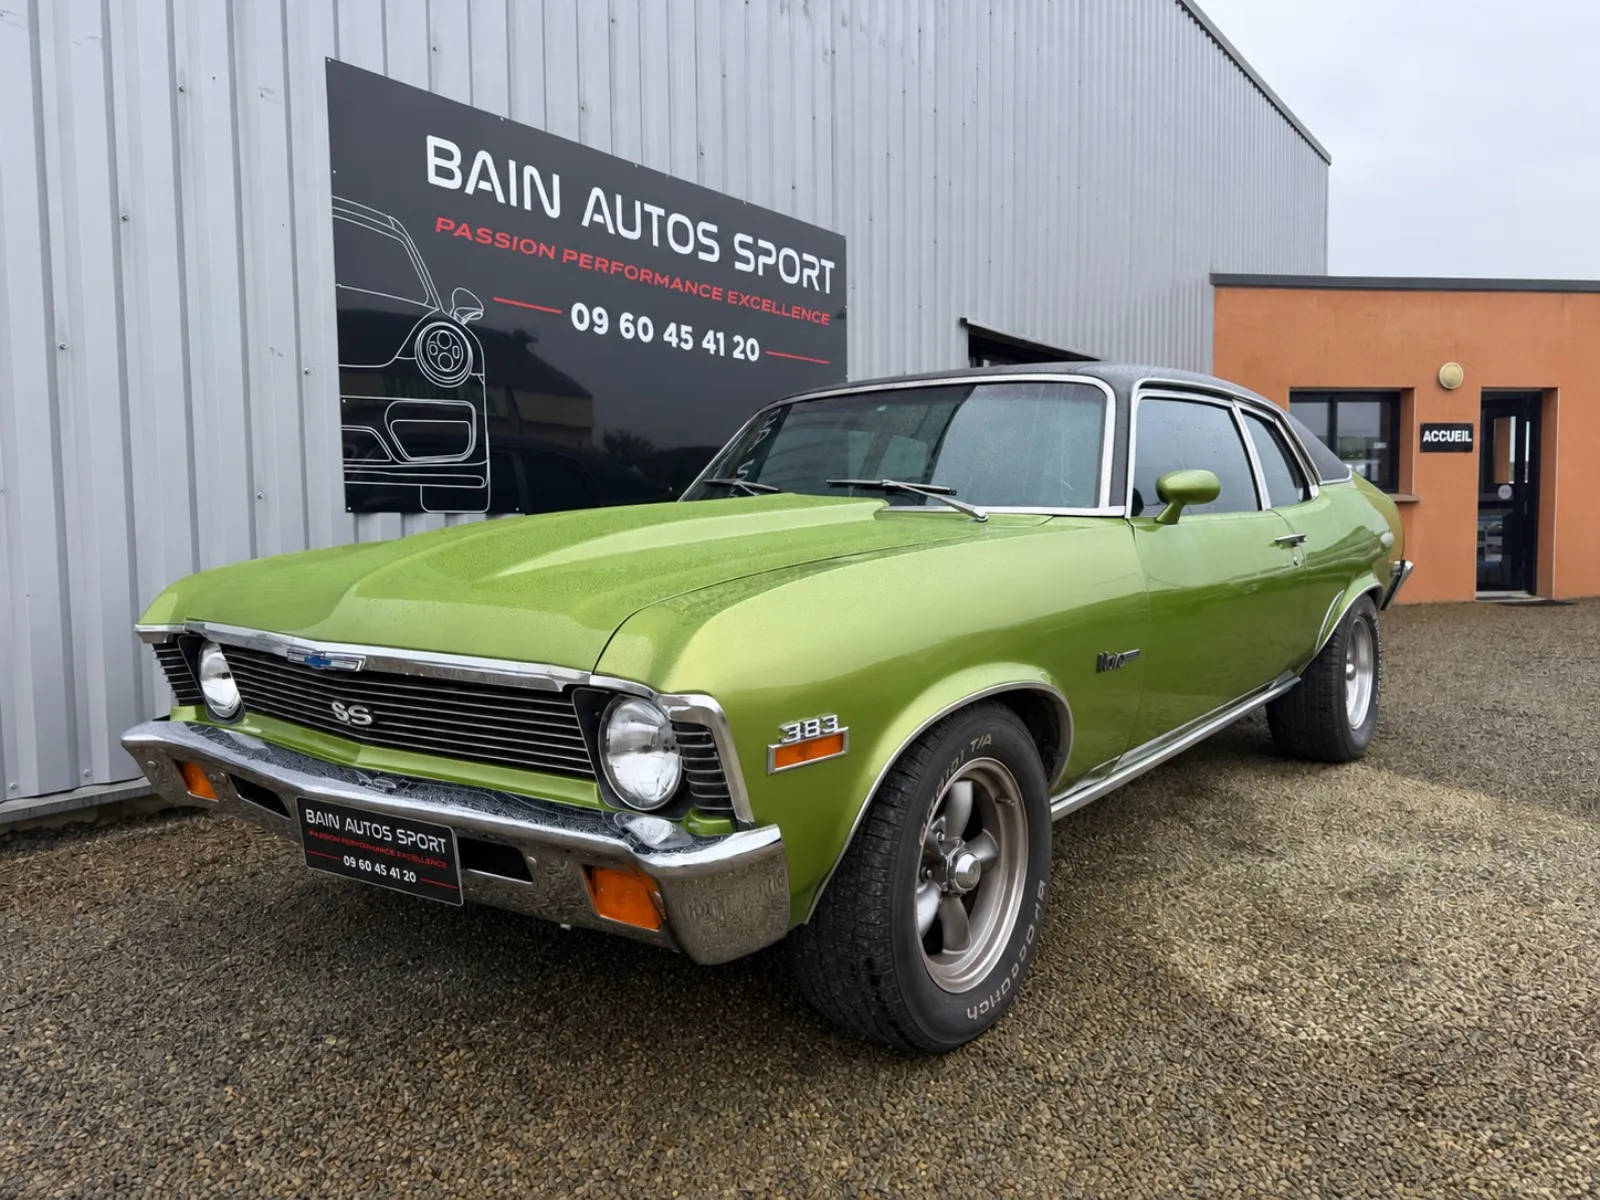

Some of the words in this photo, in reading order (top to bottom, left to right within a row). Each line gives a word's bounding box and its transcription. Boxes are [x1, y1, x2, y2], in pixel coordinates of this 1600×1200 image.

[426, 134, 560, 219] BAIN
[581, 186, 720, 263] AUTOS
[733, 235, 835, 294] SPORT
[435, 216, 556, 261] PASSION
[562, 248, 723, 301] PERFORMANCE
[727, 290, 831, 326] EXCELLENCE
[570, 302, 609, 335] 09
[619, 312, 654, 343] 60
[663, 322, 694, 351] 45
[701, 330, 725, 357] 41
[732, 335, 760, 362] 20
[1422, 429, 1473, 443] ACCUEIL
[331, 701, 373, 726] SS
[778, 714, 838, 743] 383
[970, 733, 992, 753] T/A
[305, 808, 340, 830] BAIN
[345, 817, 392, 842] AUTOS
[396, 828, 447, 854] SPORT
[343, 855, 357, 868] 09
[358, 857, 372, 872] 60
[374, 862, 388, 876] 45
[389, 866, 401, 880] 41
[402, 869, 417, 883] 20
